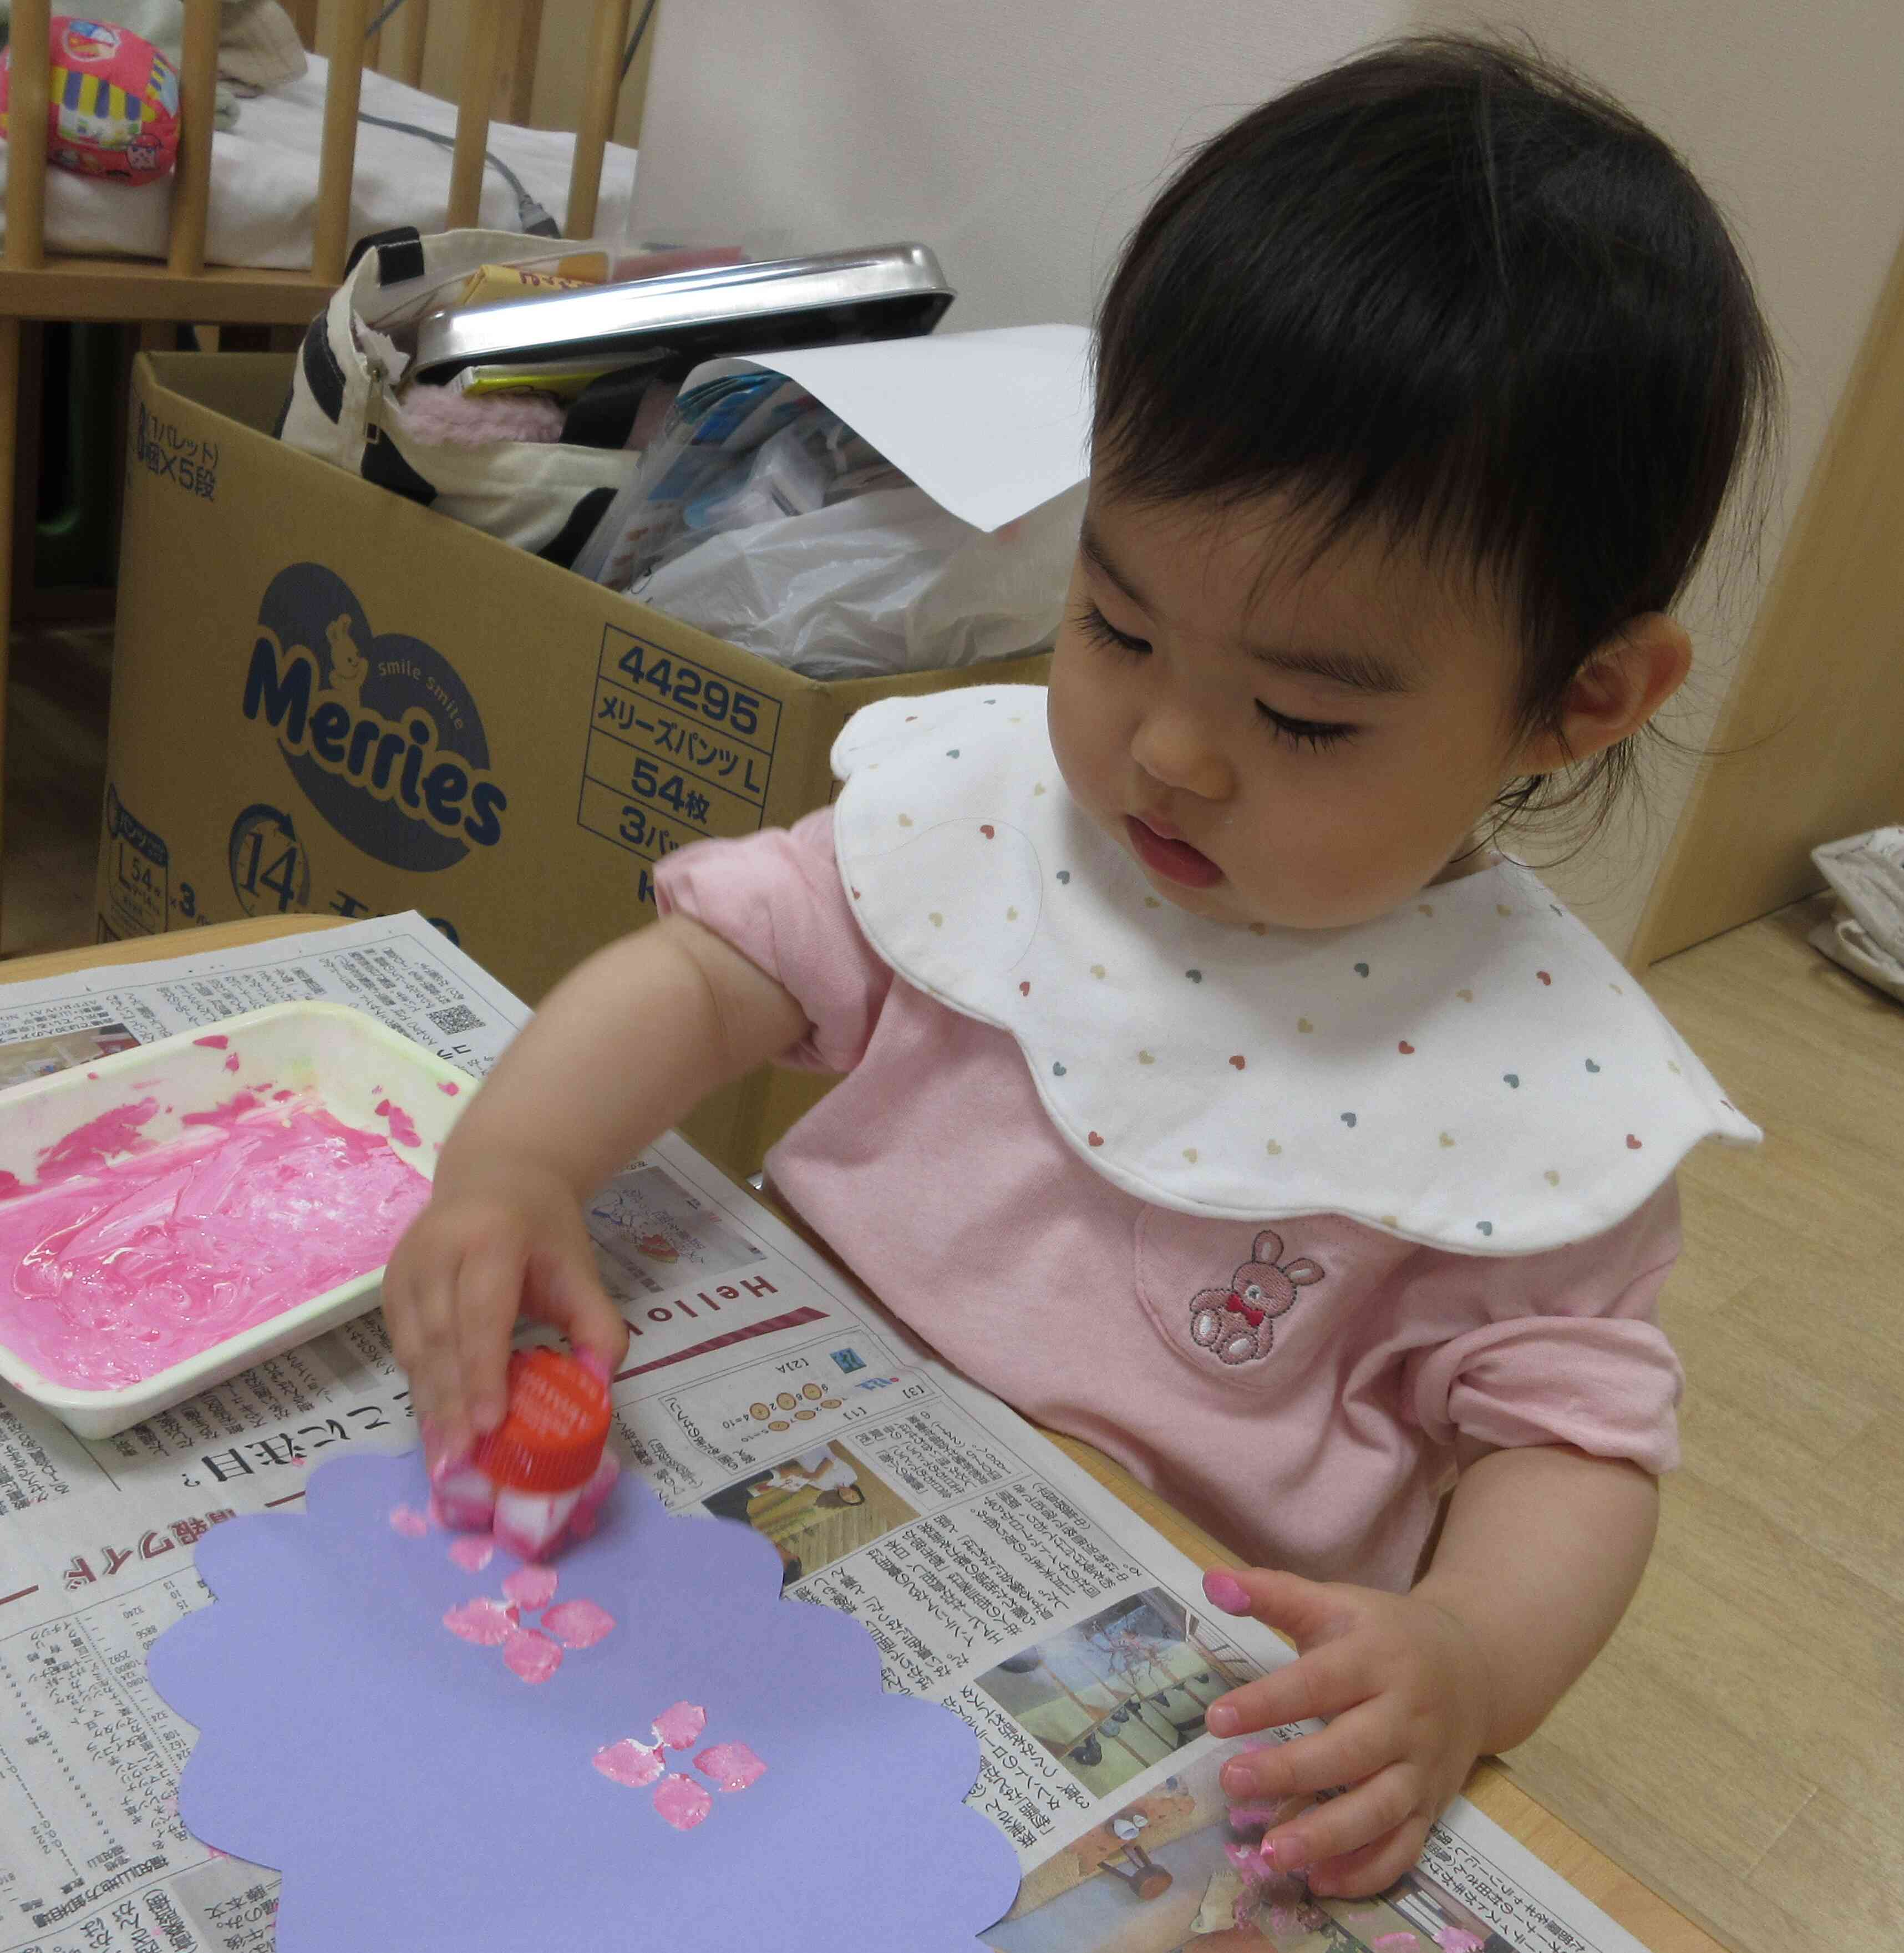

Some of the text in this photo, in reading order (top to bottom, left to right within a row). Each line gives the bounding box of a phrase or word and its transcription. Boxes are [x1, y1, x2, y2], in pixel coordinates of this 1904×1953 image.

[618, 646, 760, 735] 44295
[242, 637, 507, 847] Merries
[598, 696, 738, 777] メリーズパンツ
[631, 757, 710, 824] 54枚
[647, 1276, 778, 1322] Hello
[182, 1391, 413, 1488] こに注目?
